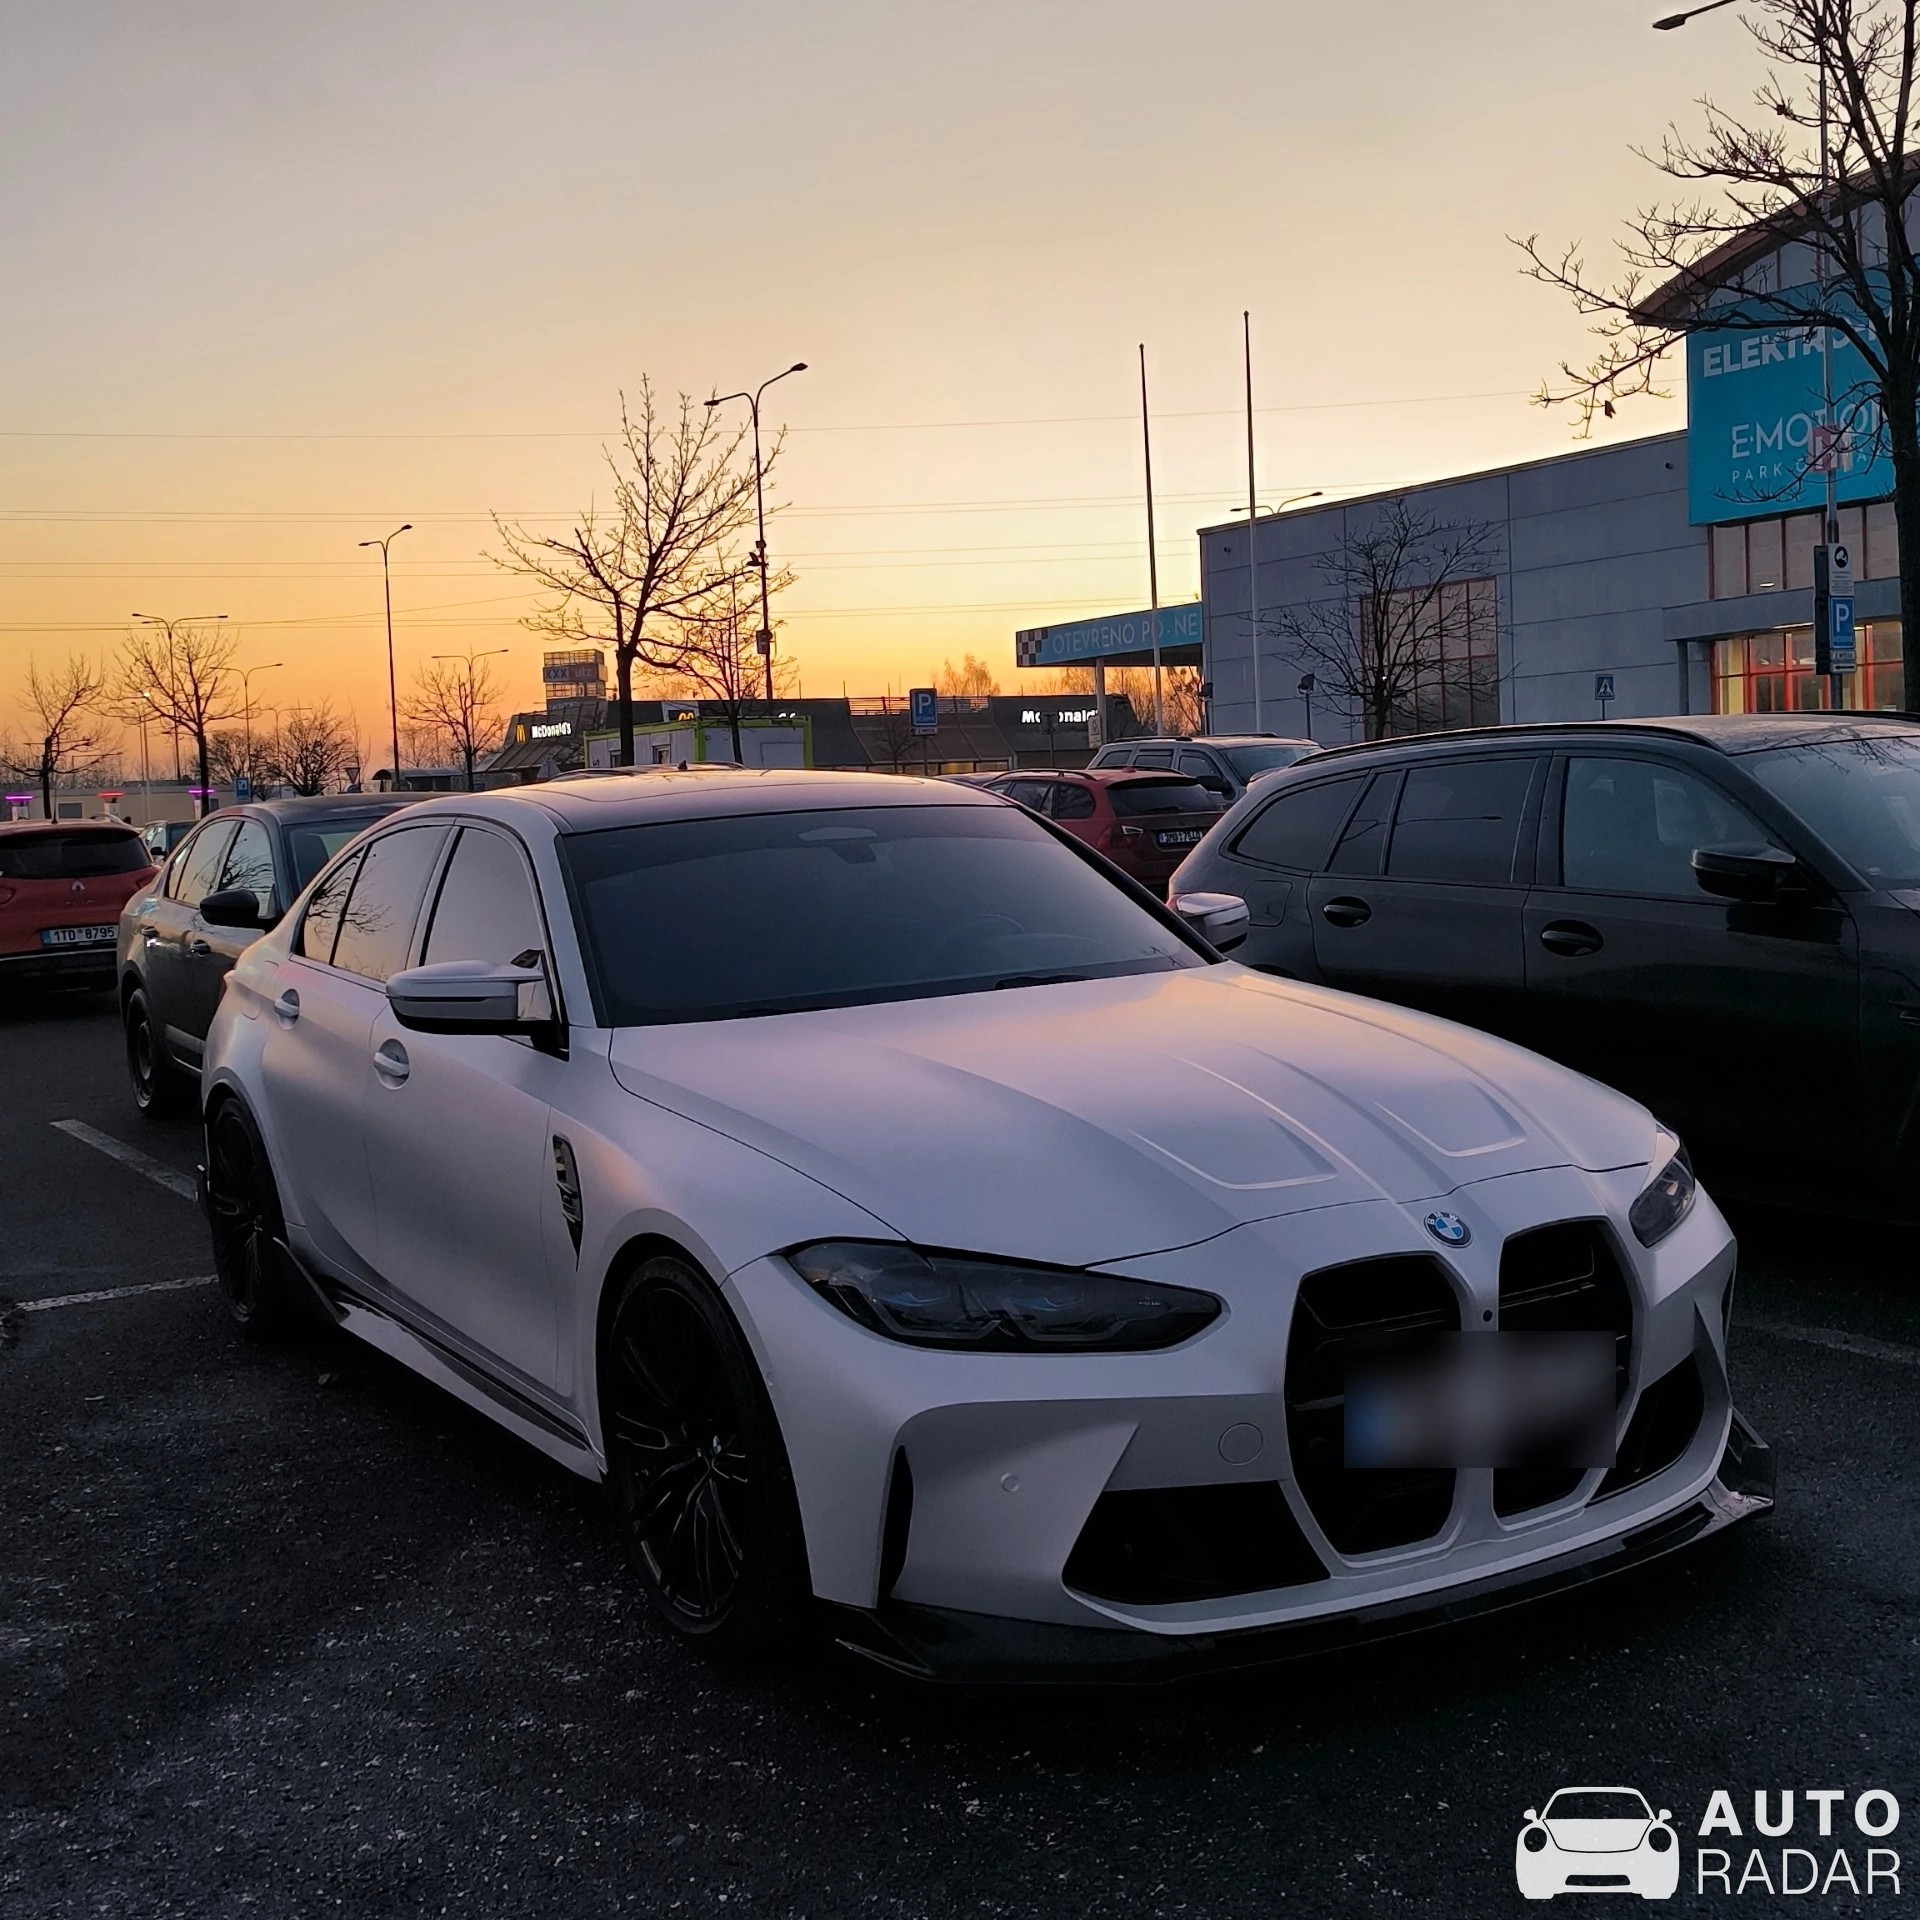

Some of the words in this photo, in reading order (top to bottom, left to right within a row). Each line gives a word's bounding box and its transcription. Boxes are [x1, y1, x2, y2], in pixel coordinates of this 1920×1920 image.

[1732, 462, 1783, 484] PARK
[1835, 603, 1850, 633] P
[1053, 622, 1135, 655] OTEVŘENO
[918, 693, 931, 715] P
[531, 721, 572, 739] McDonald's
[54, 930, 76, 942] 1TD
[85, 926, 115, 940] 8795
[1428, 1211, 1458, 1225] BMW
